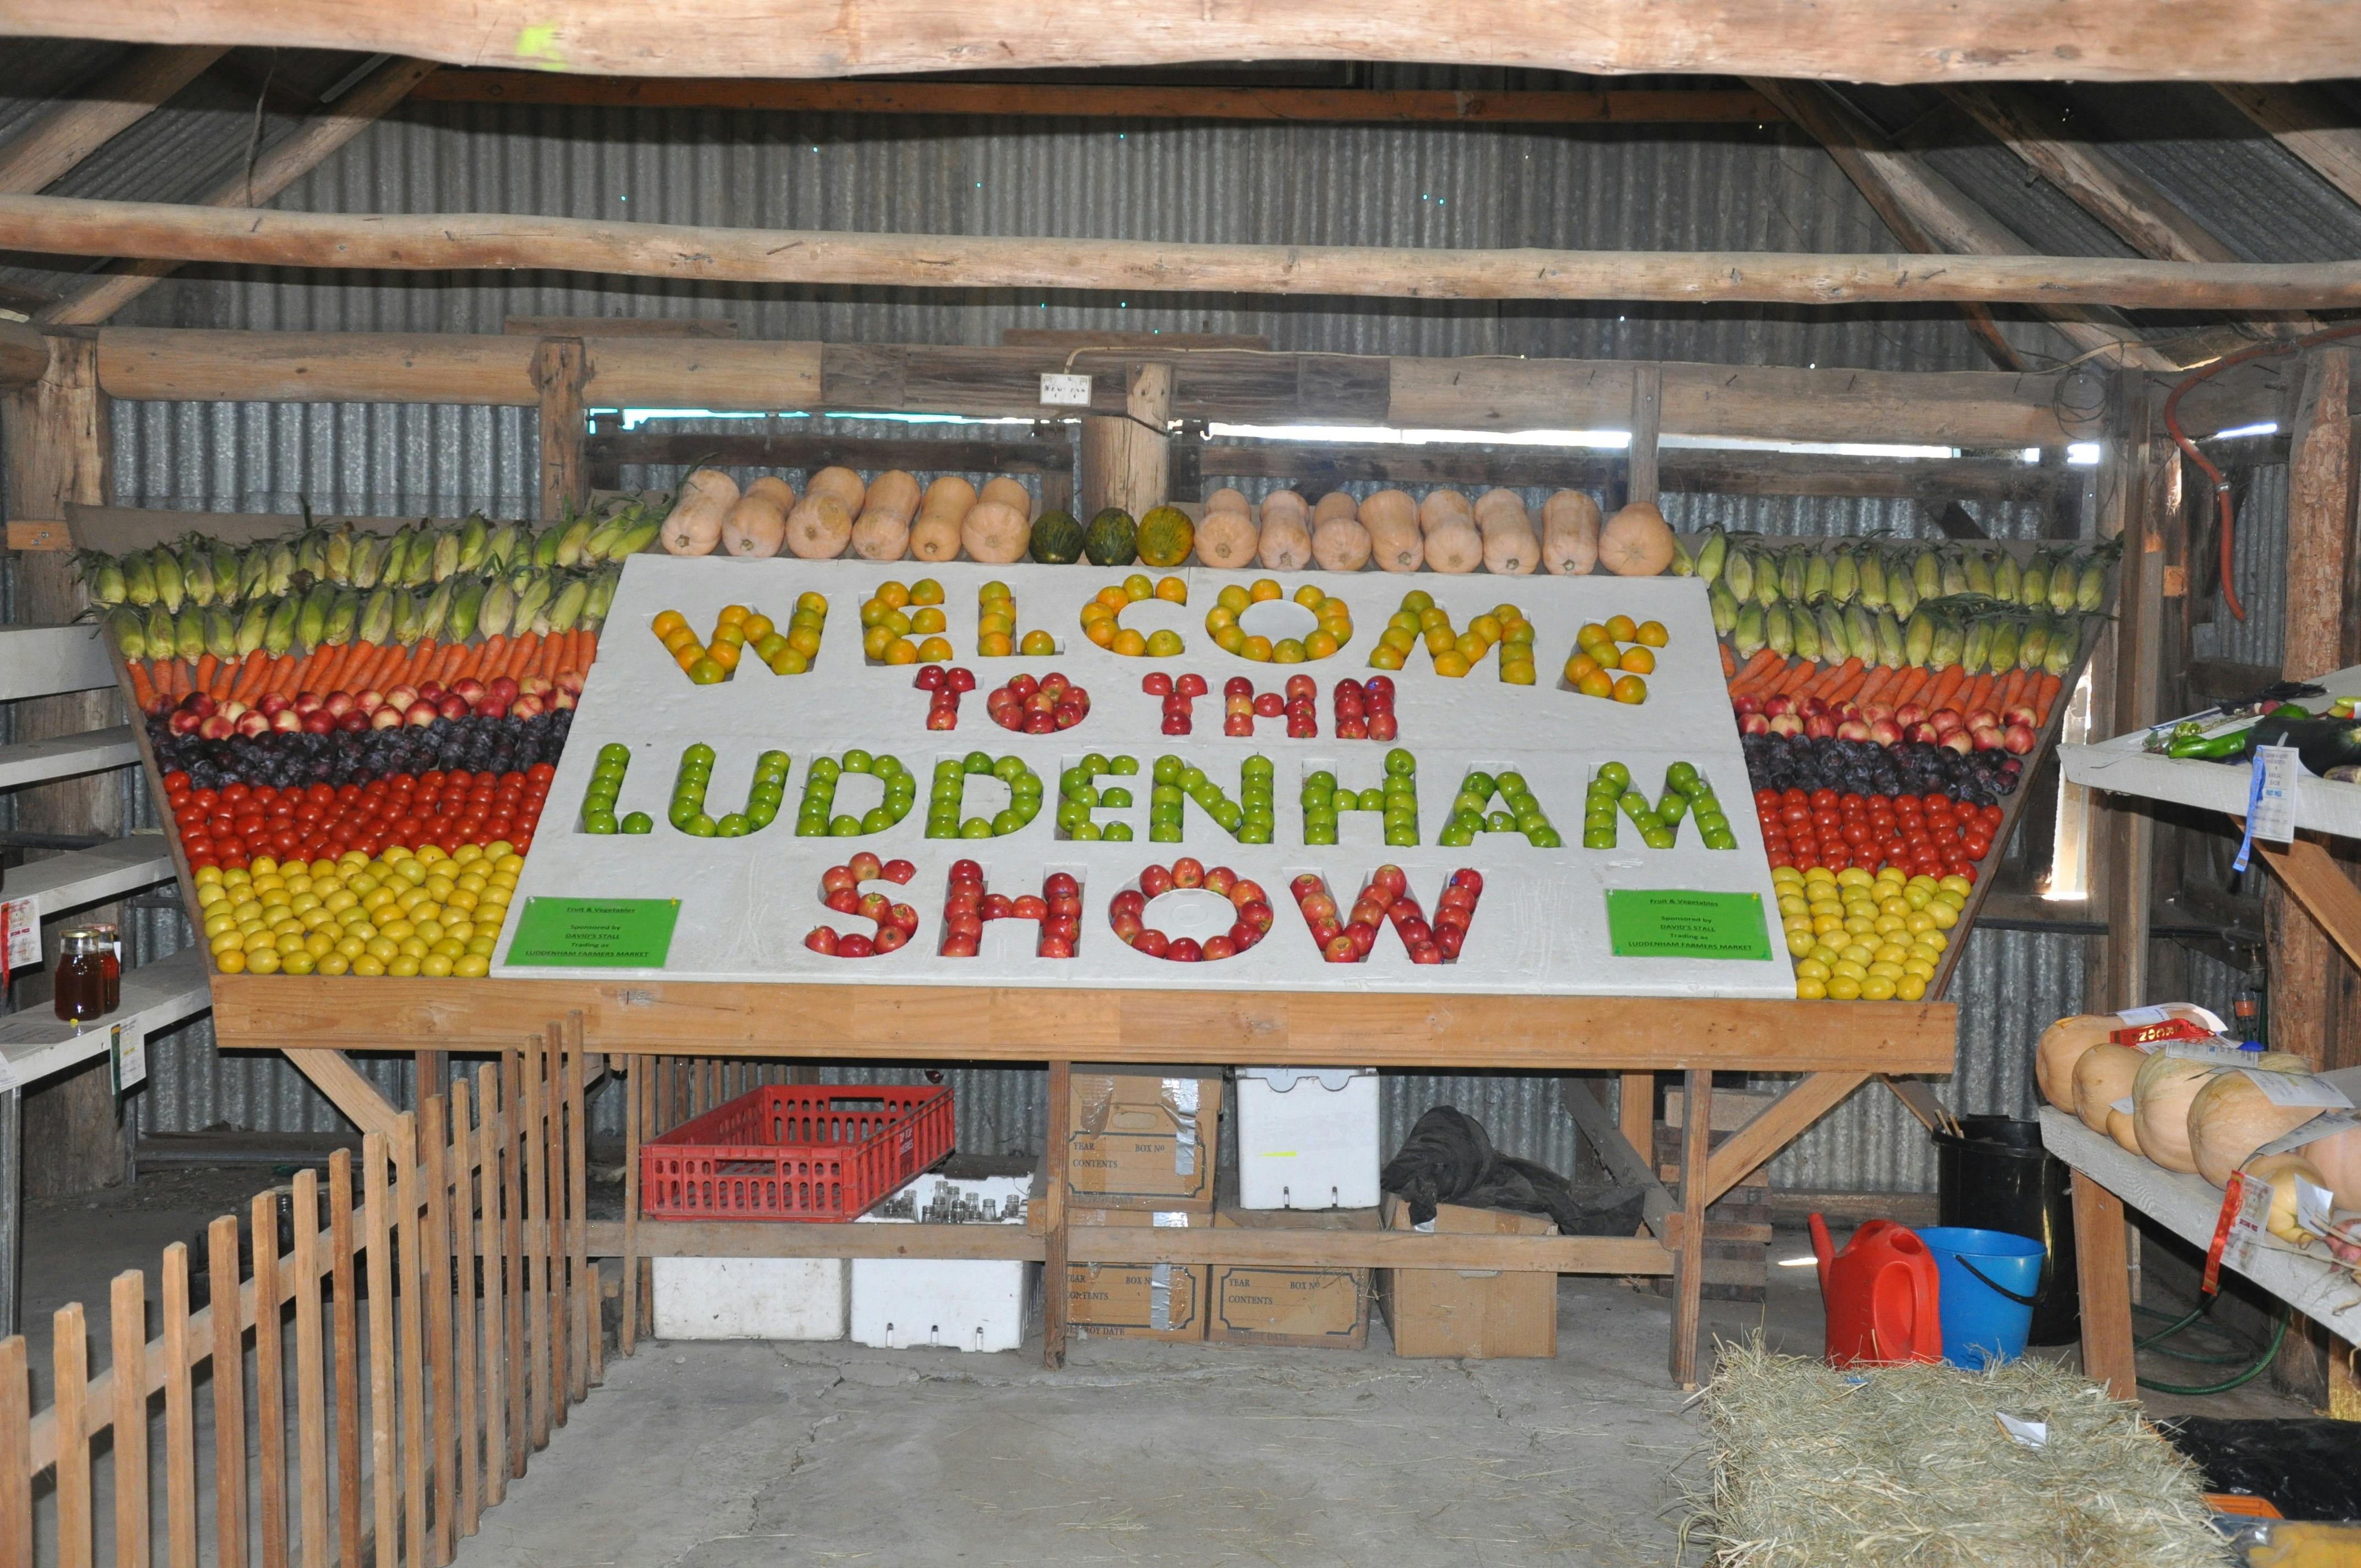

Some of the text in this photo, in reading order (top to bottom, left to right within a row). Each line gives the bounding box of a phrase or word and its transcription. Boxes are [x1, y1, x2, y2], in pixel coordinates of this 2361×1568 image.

[643, 574, 1668, 705] WELCOME
[913, 665, 1092, 736] TO
[572, 742, 1739, 850] LUDDENHAM
[803, 851, 1488, 964] SHOW
[1677, 899, 1718, 907] Vegetables
[1073, 1142, 1095, 1151] YEAR
[1135, 1144, 1152, 1152] BOX
[1073, 1159, 1118, 1168] CONTENTS
[1125, 1276, 1141, 1284] BOX
[1229, 1278, 1250, 1287] YEAR
[1290, 1281, 1306, 1290] BOX
[1228, 1295, 1273, 1305] CONTENTS
[1266, 1332, 1289, 1341] DATE
